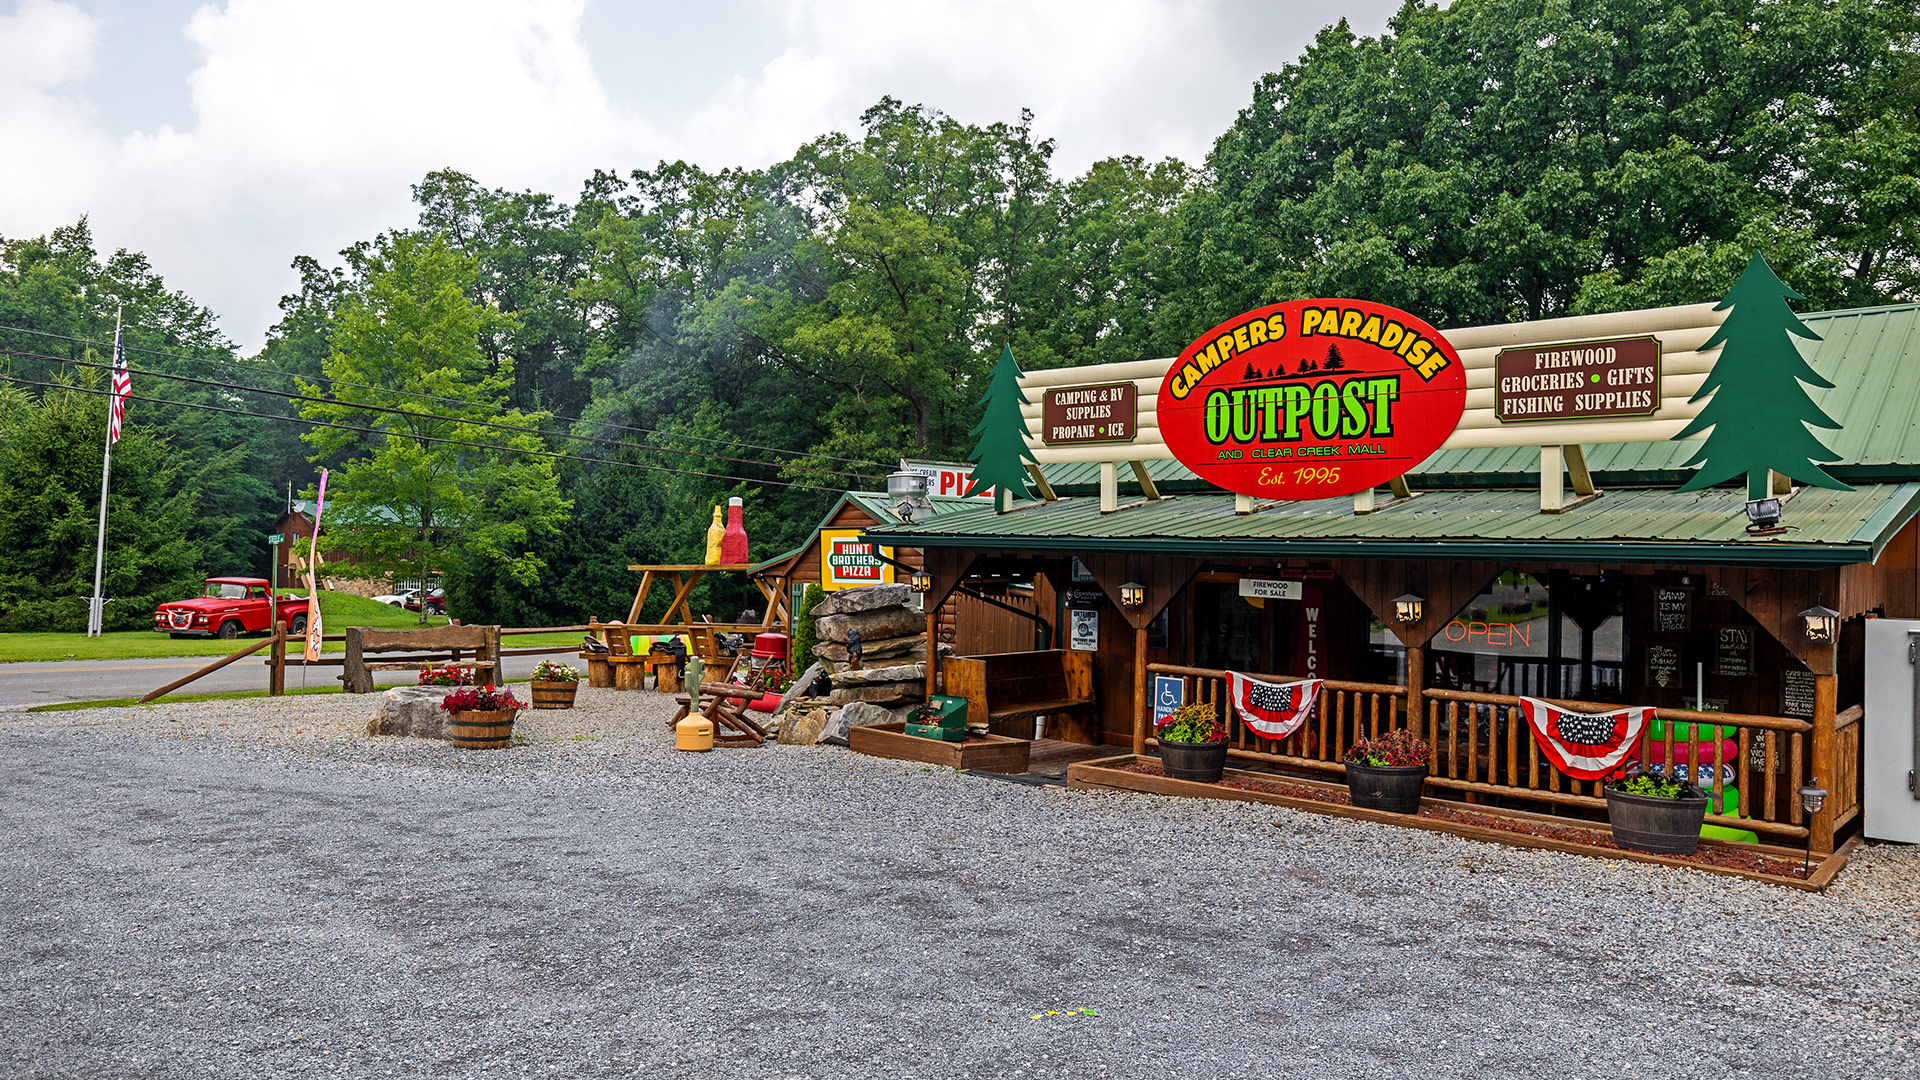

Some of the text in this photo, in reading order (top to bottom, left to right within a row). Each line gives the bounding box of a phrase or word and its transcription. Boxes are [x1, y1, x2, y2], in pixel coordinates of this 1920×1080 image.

[1169, 306, 1452, 400] CAMPERS PARADISE
[1535, 347, 1617, 370] FIREWOOD
[1501, 366, 1654, 393] GROCERIES GIFTS
[1055, 387, 1124, 406] CAMPING & RV
[1503, 390, 1652, 415] FISHING SUPPLIES
[1066, 404, 1111, 420] SUPPLIES
[1204, 375, 1400, 444] OUTPOST
[1052, 422, 1124, 439] PROPANE ICE
[1217, 444, 1386, 460] AND CLEAR CREEK MALL
[1257, 466, 1341, 486] Est. 1995
[842, 544, 869, 554] HUNT
[832, 555, 881, 566] BROTHERS
[842, 566, 871, 576] PIZZA
[1253, 581, 1288, 589] FIREWOOD
[1659, 602, 1686, 611] IS MY
[1445, 620, 1530, 647] OPEN
[1720, 628, 1749, 643] STAY
